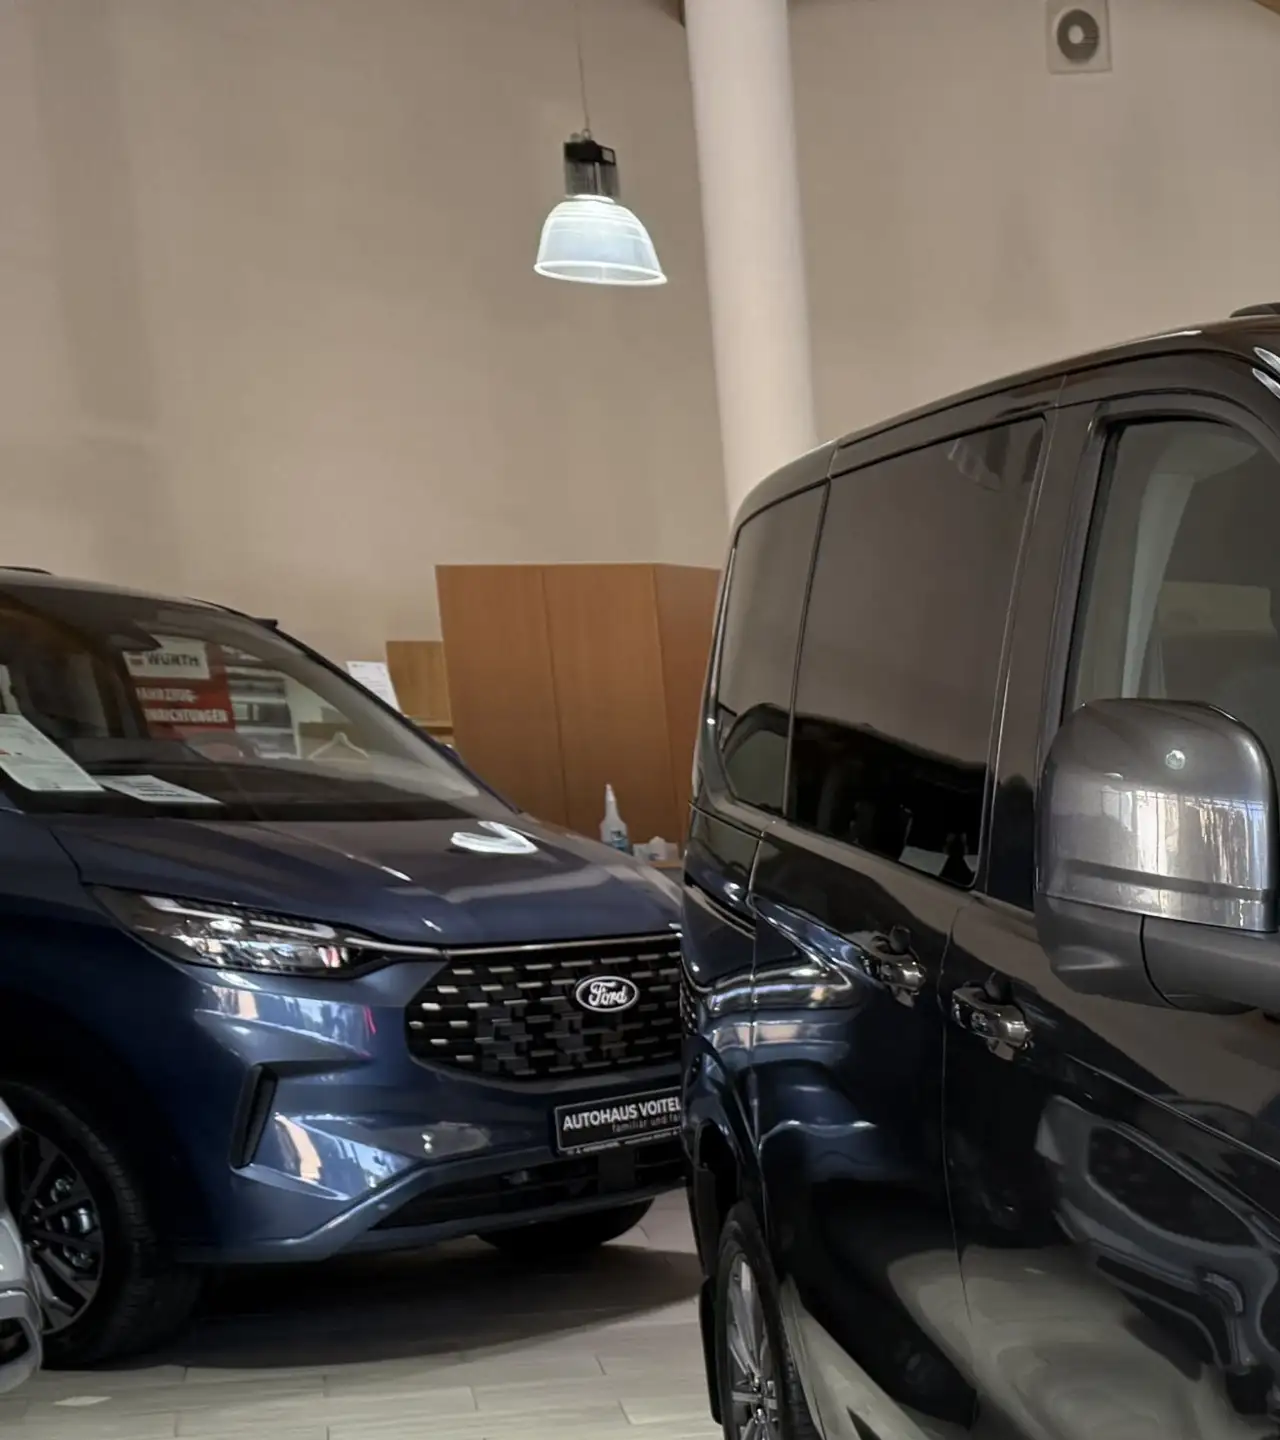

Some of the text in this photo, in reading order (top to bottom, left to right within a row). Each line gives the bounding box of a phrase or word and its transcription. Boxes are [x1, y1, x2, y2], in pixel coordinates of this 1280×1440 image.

[588, 981, 628, 1006] Ford
[562, 1096, 681, 1131] AUTOHAUS VOITEL
